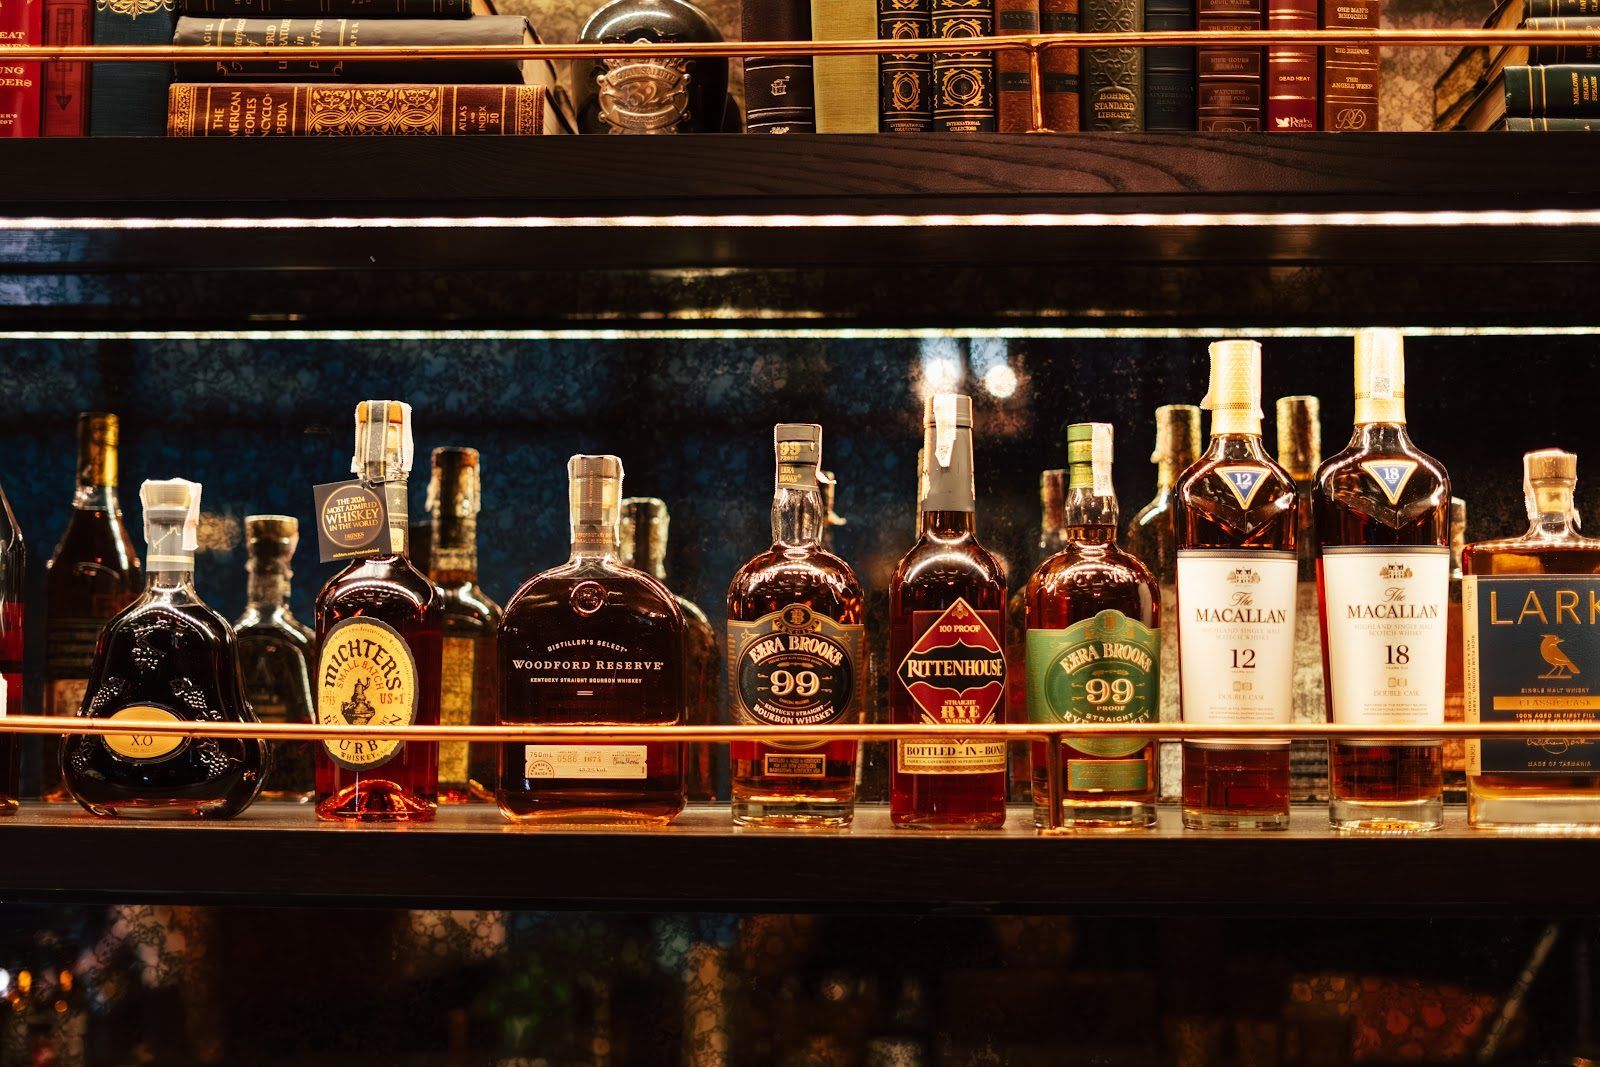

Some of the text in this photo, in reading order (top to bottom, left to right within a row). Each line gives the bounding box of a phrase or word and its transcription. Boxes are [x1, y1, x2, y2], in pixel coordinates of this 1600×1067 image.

[203, 23, 214, 47] GILL
[265, 24, 276, 47] ORLD
[229, 91, 242, 137] MERICAN
[1094, 102, 1135, 111] STANDARD
[213, 107, 225, 130] THE
[245, 97, 257, 137] EOPLES
[260, 93, 273, 137] NCYCLO-
[276, 102, 288, 134] PEDIA
[459, 105, 468, 132] ATLAS
[478, 105, 487, 132] INDEX
[489, 112, 500, 124] 20
[1097, 111, 1132, 119] LIBRARY
[779, 441, 801, 456] 99
[1235, 473, 1253, 485] 12
[1384, 467, 1400, 480] 18
[327, 501, 378, 515] MOST ADMIRED
[336, 496, 366, 506] THE 2024
[325, 508, 380, 525] WHISKEY
[329, 524, 338, 532] IN
[352, 519, 379, 528] WORLD
[1230, 591, 1253, 607] The
[1382, 587, 1406, 602] The
[1195, 608, 1288, 623] MACALLAN
[1346, 604, 1438, 619] MACALLAN
[939, 625, 980, 633] 100 PROOF
[547, 639, 626, 653] DISTILLER'S SELECT
[748, 635, 844, 667] EZRA BROOKS
[1060, 642, 1153, 675] EZRA BROOKS
[1230, 648, 1256, 669] 12
[1384, 645, 1410, 665] 18
[512, 659, 663, 671] WOODFORD RESERVE
[907, 659, 1003, 678] RITTENHOUSE
[336, 660, 385, 691] SMALL BATCH
[770, 669, 820, 697] 99
[1085, 678, 1135, 705] 99
[753, 703, 836, 725] BOURBON WHISKEY
[764, 702, 796, 717] KENTUCKY
[795, 703, 826, 717] STRAIGHT
[940, 705, 980, 719] RYE
[1085, 712, 1135, 723] STRAIGHT
[340, 751, 376, 762] WHISKEY
[906, 746, 956, 756] BOTTLED
[965, 746, 977, 755] IN
